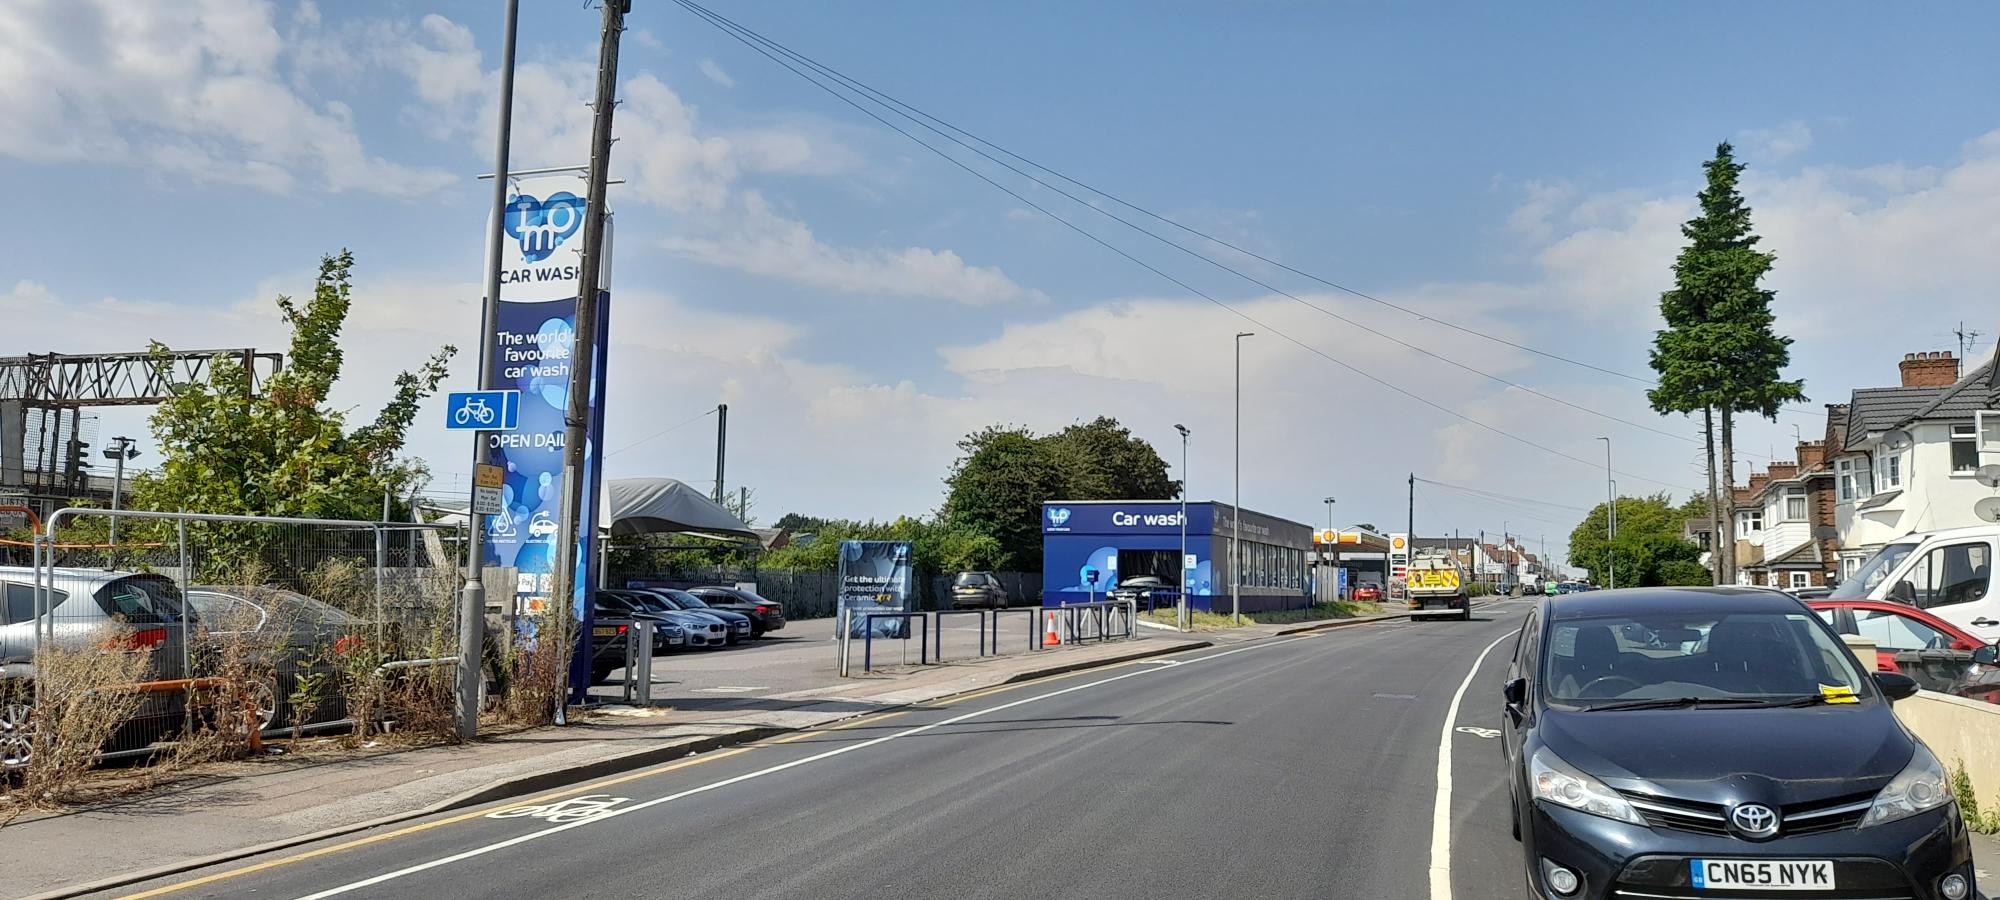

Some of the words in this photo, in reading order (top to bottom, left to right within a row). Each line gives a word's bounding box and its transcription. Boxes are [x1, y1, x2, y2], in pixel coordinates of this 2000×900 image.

[501, 268, 531, 284] CAR
[497, 331, 523, 346] The
[505, 347, 570, 362] favourite
[504, 367, 527, 378] car
[530, 361, 569, 377] wash
[490, 434, 530, 448] OPEN
[1112, 511, 1140, 526] Car
[1143, 511, 1187, 526] wash
[859, 575, 873, 583] the
[844, 585, 885, 593] protection
[844, 593, 876, 601] Ceramic
[1707, 862, 1772, 884] CN65
[1779, 863, 1828, 885] NYK
